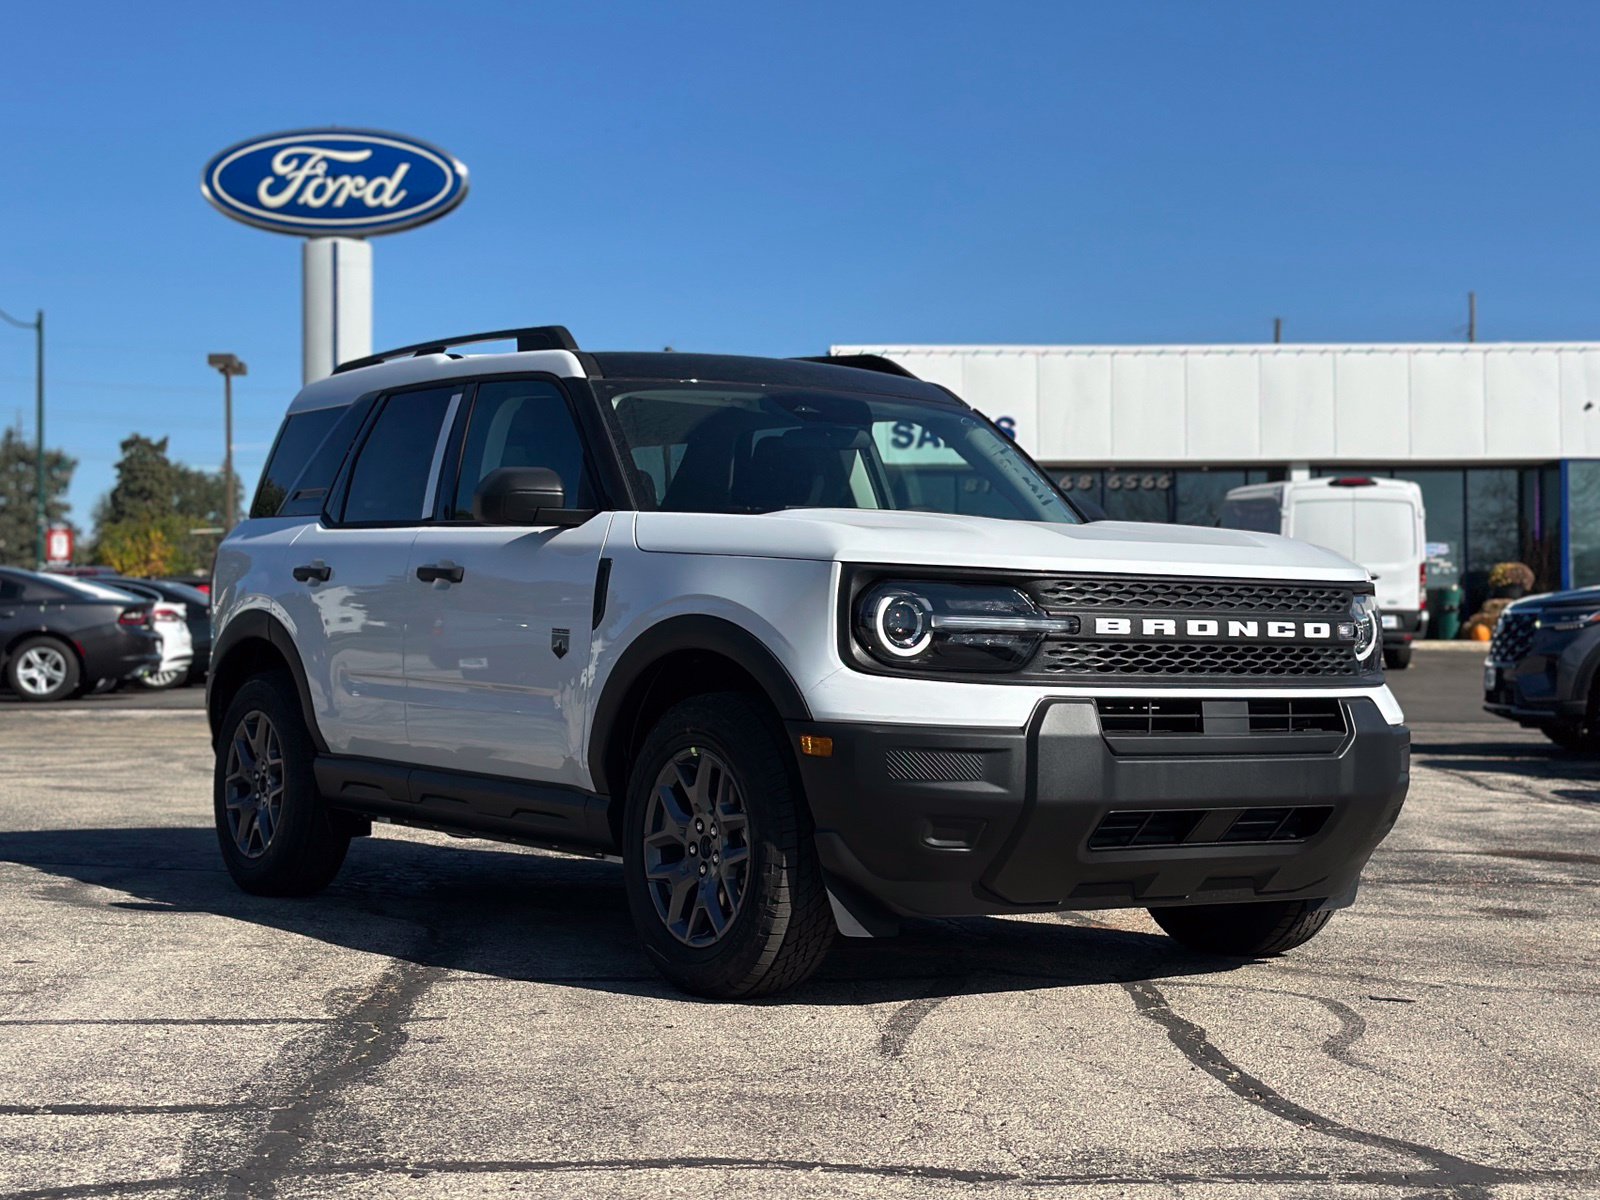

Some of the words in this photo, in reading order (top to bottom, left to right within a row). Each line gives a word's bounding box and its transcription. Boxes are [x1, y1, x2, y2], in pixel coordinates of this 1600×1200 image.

[257, 146, 410, 208] Ford
[890, 416, 1016, 450] SAS
[1095, 617, 1331, 639] BRONCO
